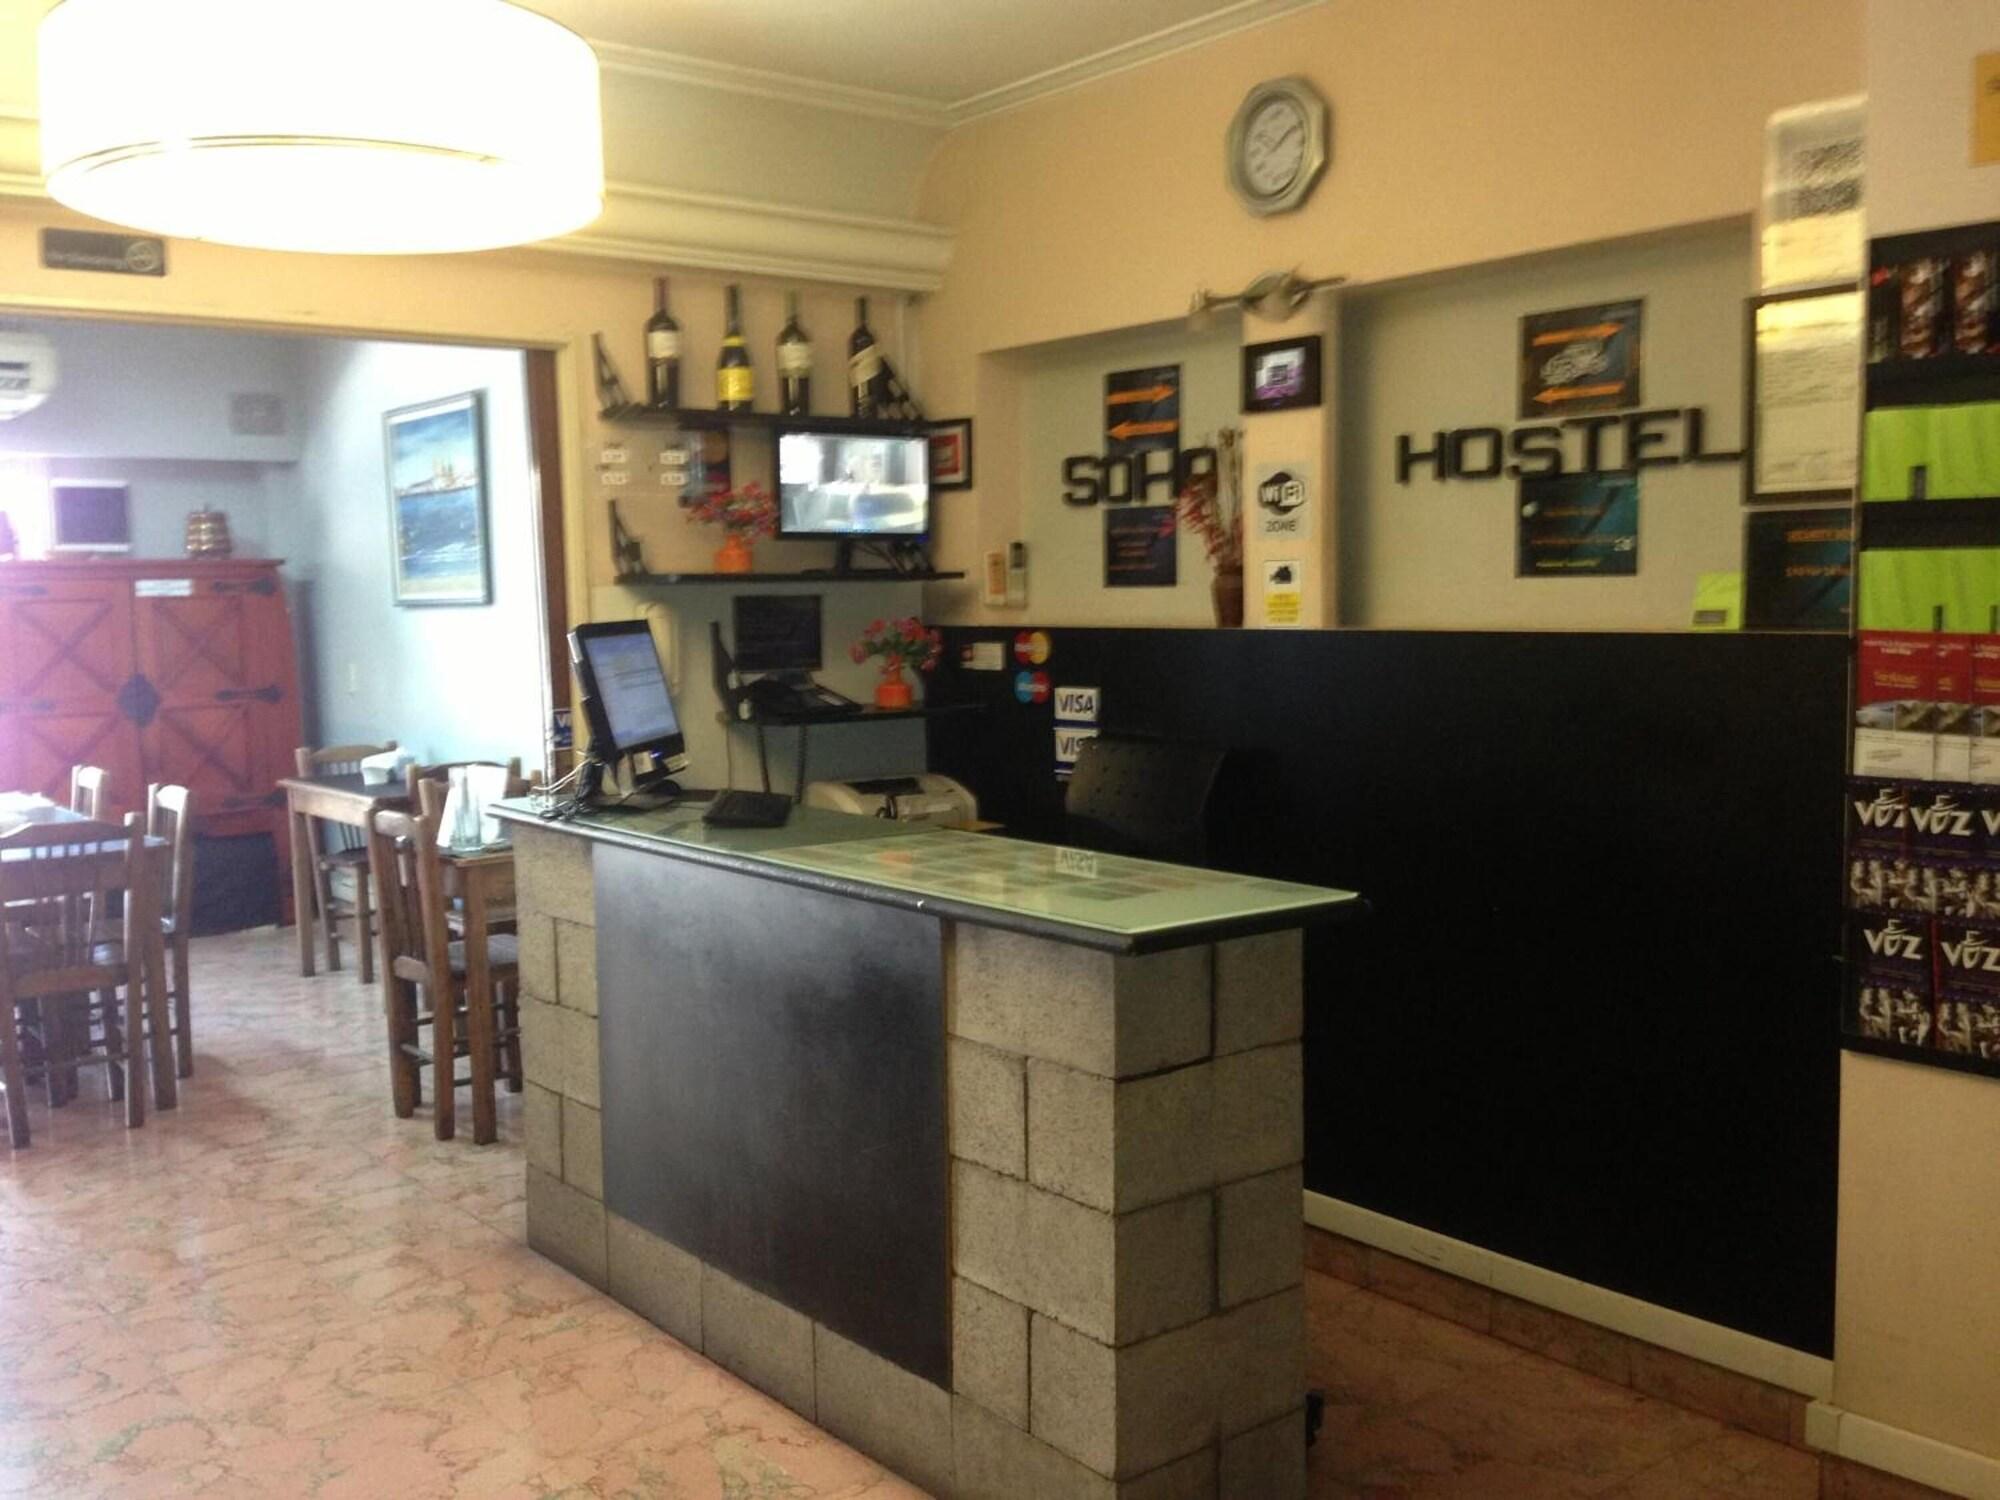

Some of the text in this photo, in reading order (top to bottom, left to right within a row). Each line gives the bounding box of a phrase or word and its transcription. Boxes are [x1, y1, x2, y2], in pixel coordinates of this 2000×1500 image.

[1395, 407, 1745, 483] HOSTEL
[1265, 519, 1297, 533] ZONE
[1059, 694, 1094, 713] VISA
[1059, 736, 1084, 755] VIS
